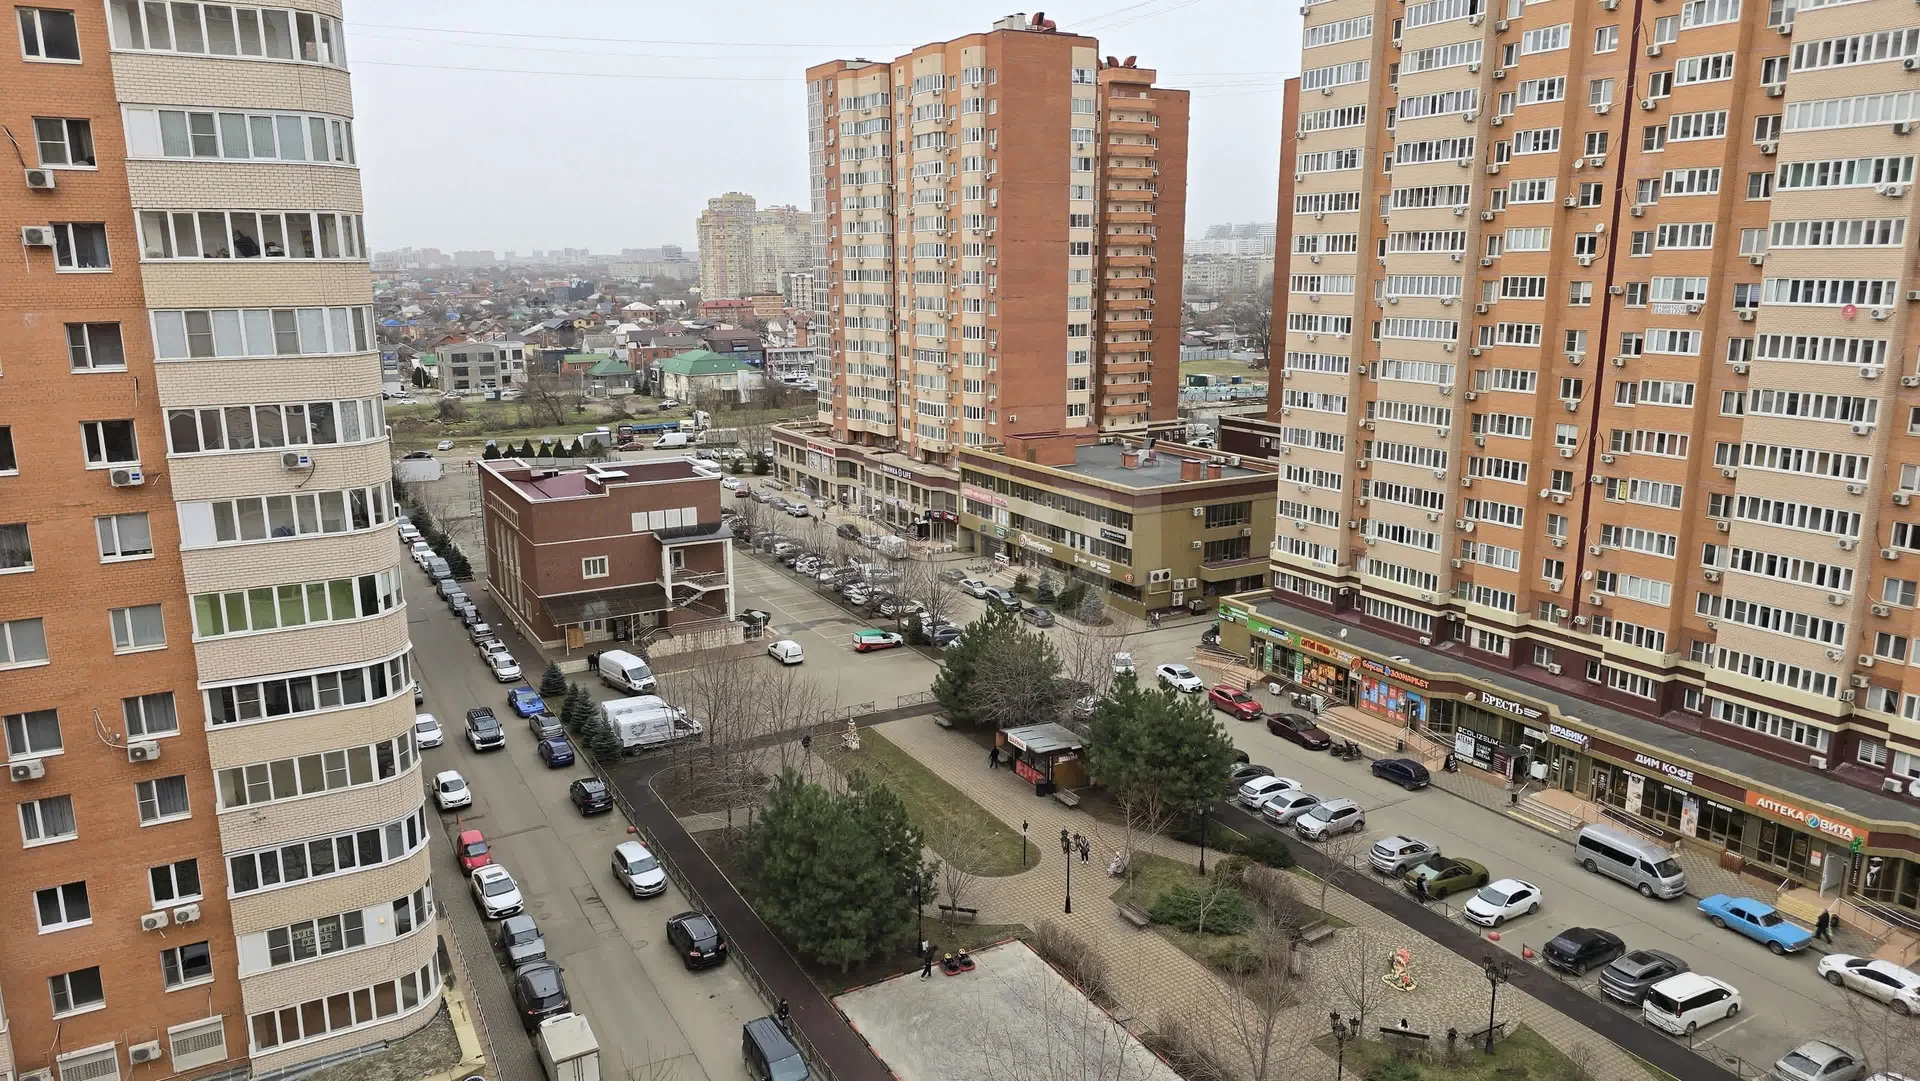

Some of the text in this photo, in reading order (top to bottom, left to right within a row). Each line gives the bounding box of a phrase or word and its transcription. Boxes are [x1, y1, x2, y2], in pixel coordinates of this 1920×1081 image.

[1481, 691, 1524, 715] БРЕСТЪ
[1634, 754, 1694, 781] ДИМ КОФЕ
[1756, 797, 1806, 821] АПТЕКА
[1819, 820, 1854, 841] ВИТА
